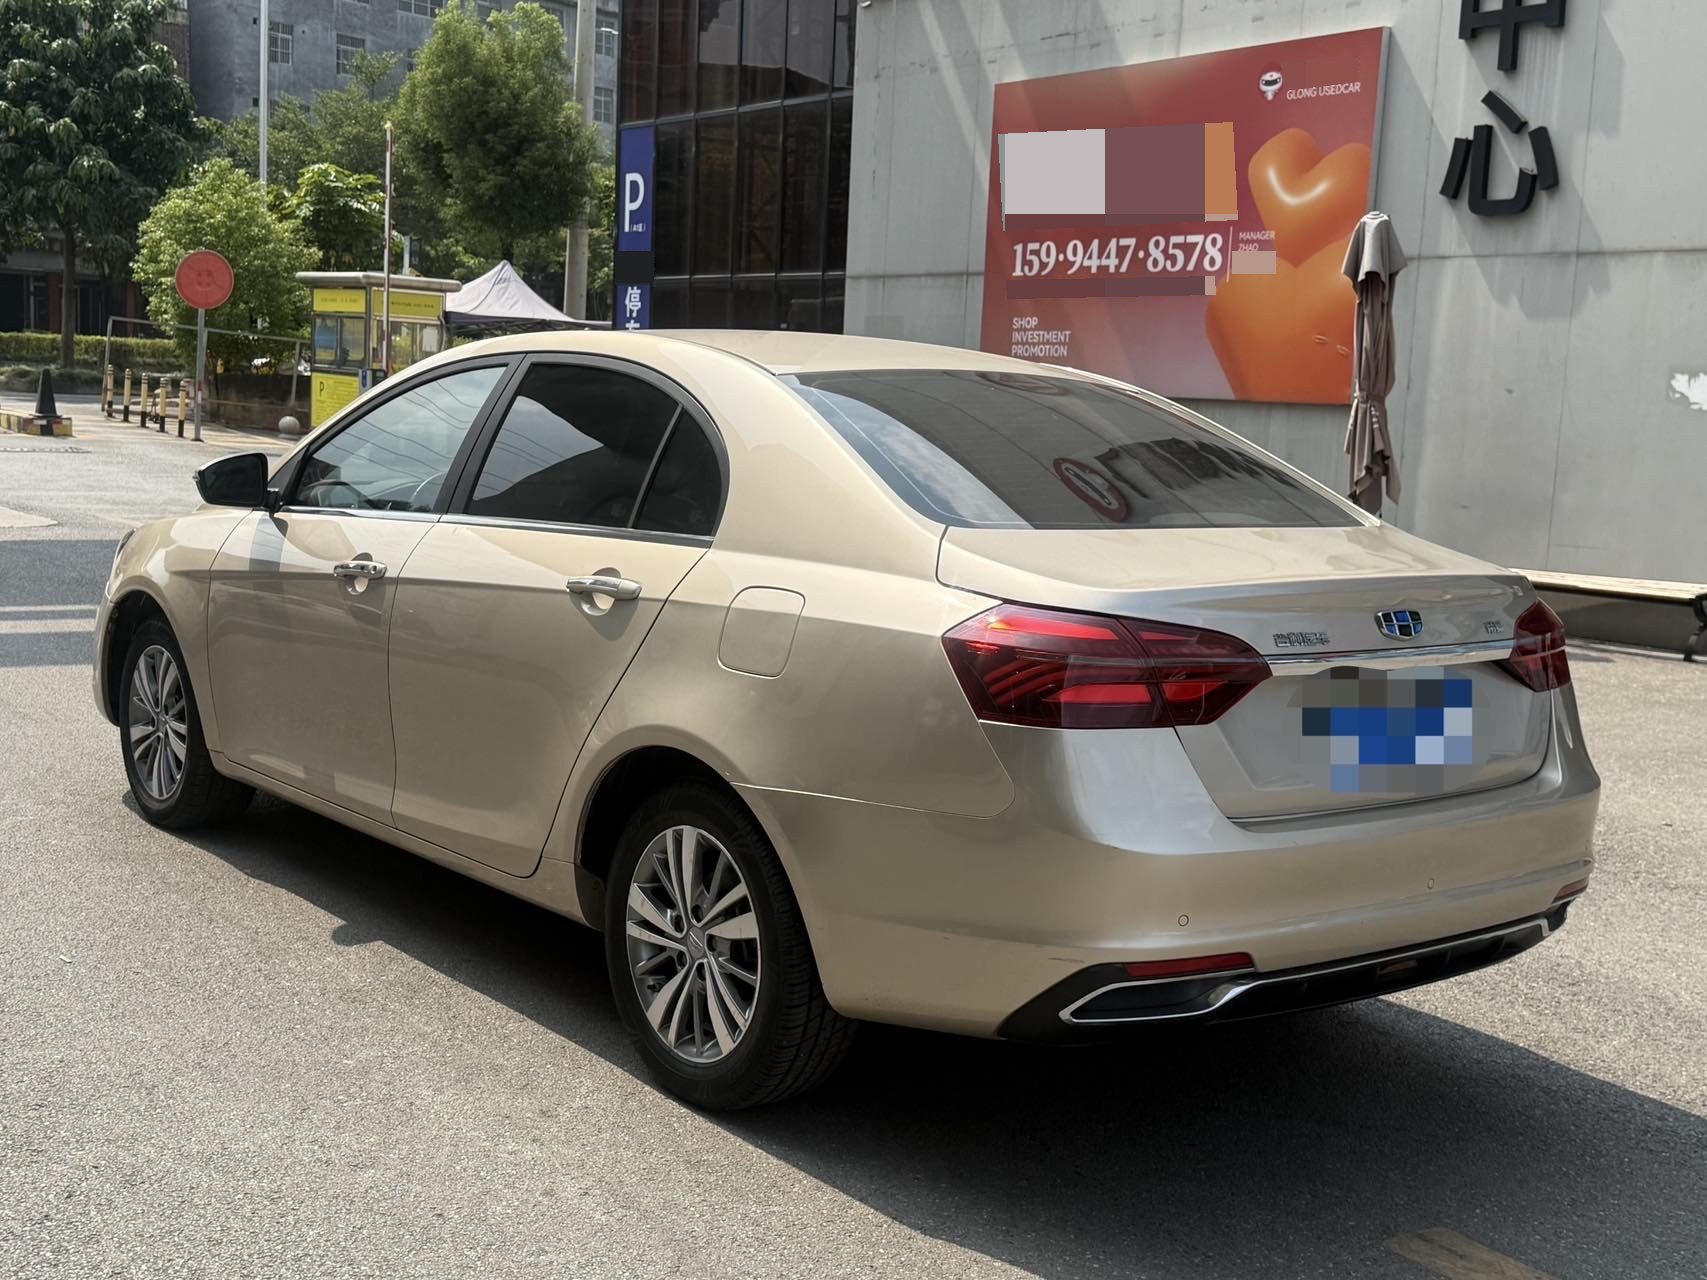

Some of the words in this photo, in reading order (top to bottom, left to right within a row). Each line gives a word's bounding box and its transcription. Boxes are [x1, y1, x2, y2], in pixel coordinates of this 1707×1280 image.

[1286, 86, 1317, 100] GLONG
[1318, 82, 1361, 97] USEDCAR
[624, 172, 645, 232] P
[1238, 230, 1276, 241] MANAGER
[1238, 243, 1259, 252] ZHAO
[1012, 316, 1039, 329] SHOP
[1012, 331, 1071, 344] INVESTMENT
[1011, 344, 1068, 358] PROMOTION
